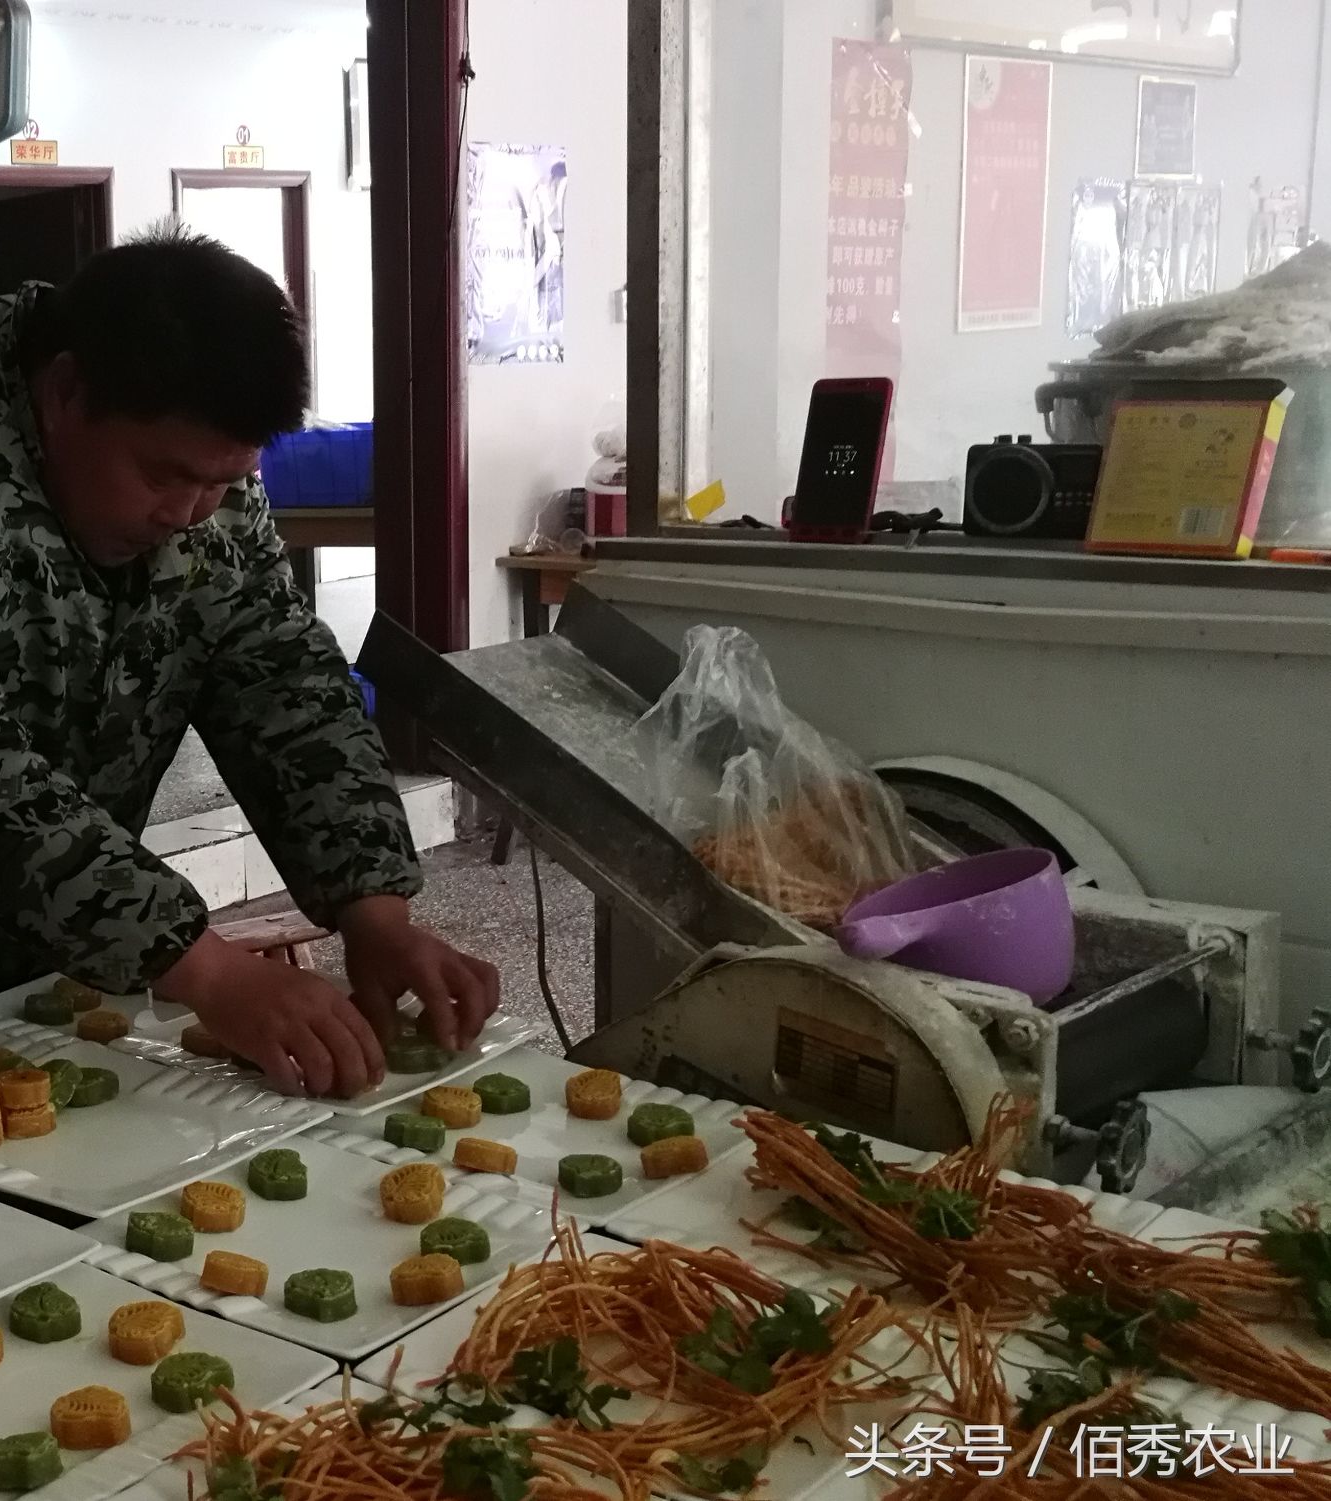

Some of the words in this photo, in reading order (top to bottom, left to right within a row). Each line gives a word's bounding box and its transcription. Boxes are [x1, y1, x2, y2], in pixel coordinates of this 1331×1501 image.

[237, 126, 250, 144] 01
[15, 144, 54, 160] 荣华厅
[227, 150, 260, 165] 富贵厅
